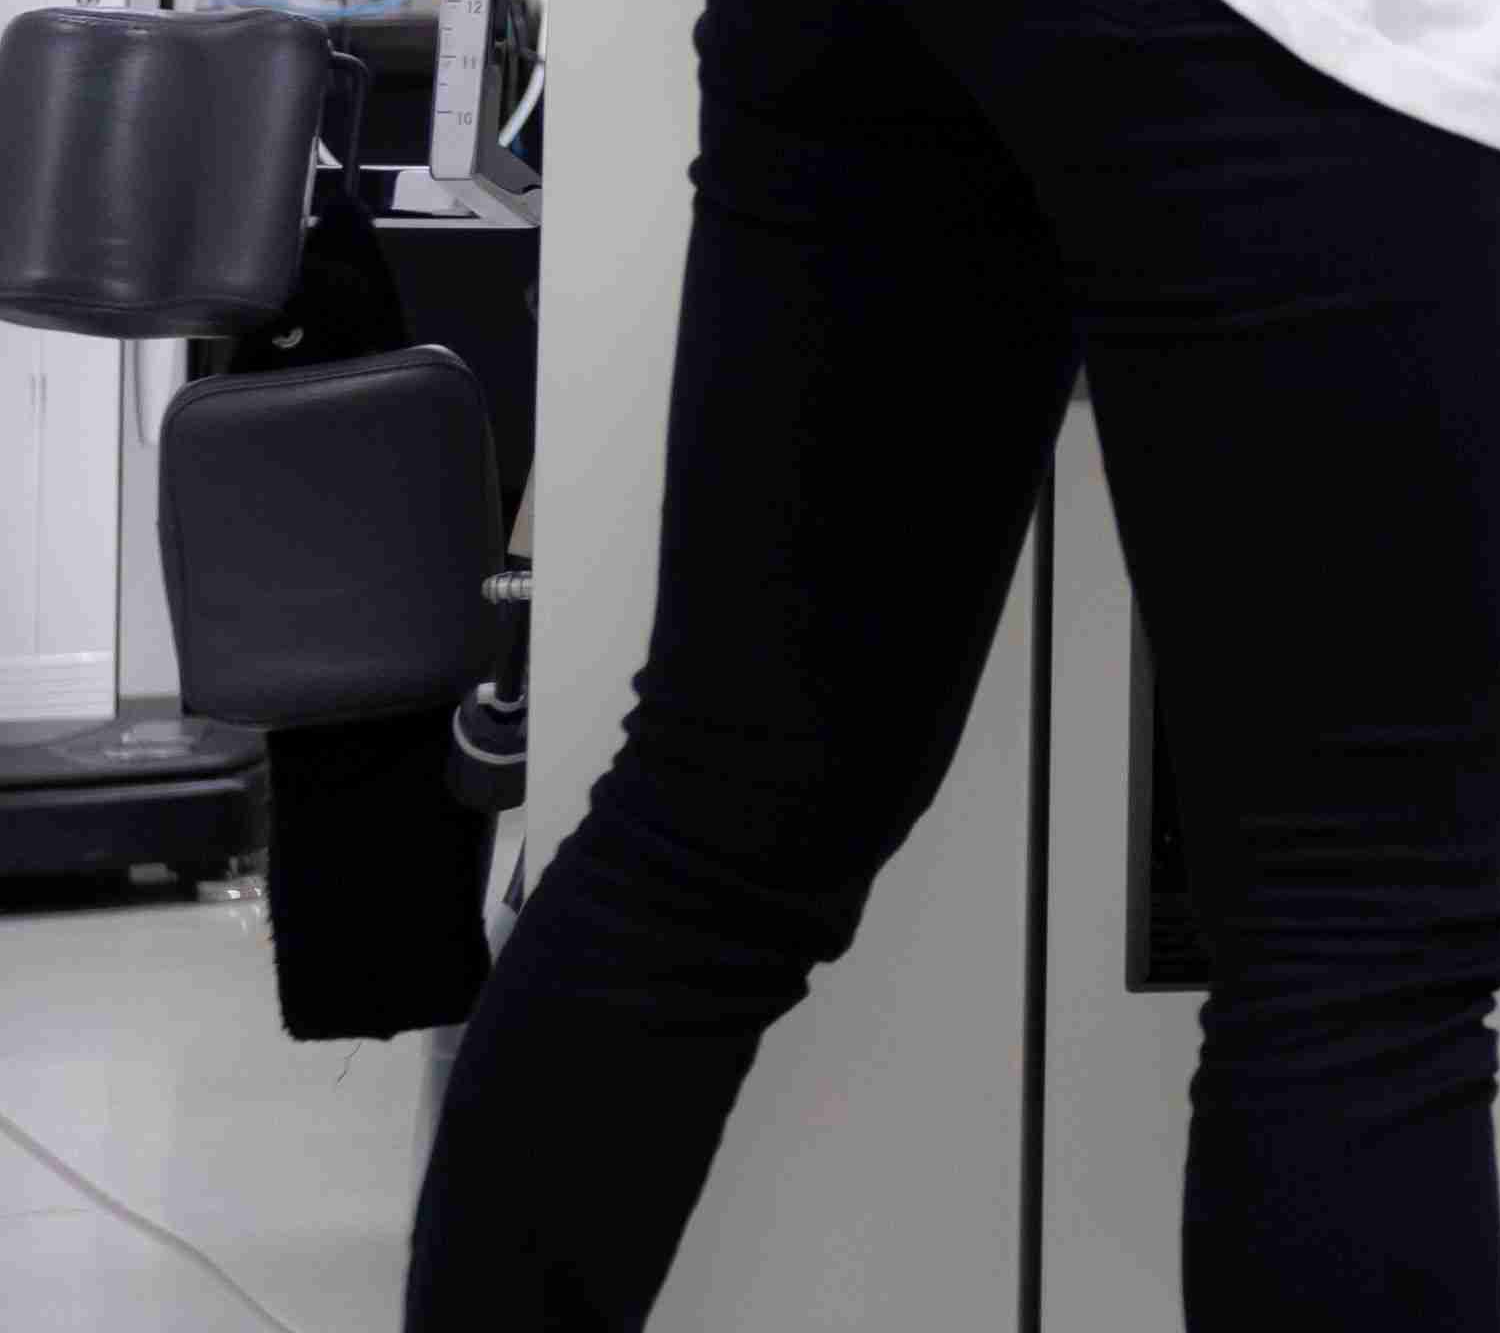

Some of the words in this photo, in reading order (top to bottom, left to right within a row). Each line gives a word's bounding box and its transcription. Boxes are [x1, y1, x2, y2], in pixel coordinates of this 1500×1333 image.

[466, 0, 483, 14] 12
[462, 56, 477, 70] 11
[457, 112, 473, 126] 10
